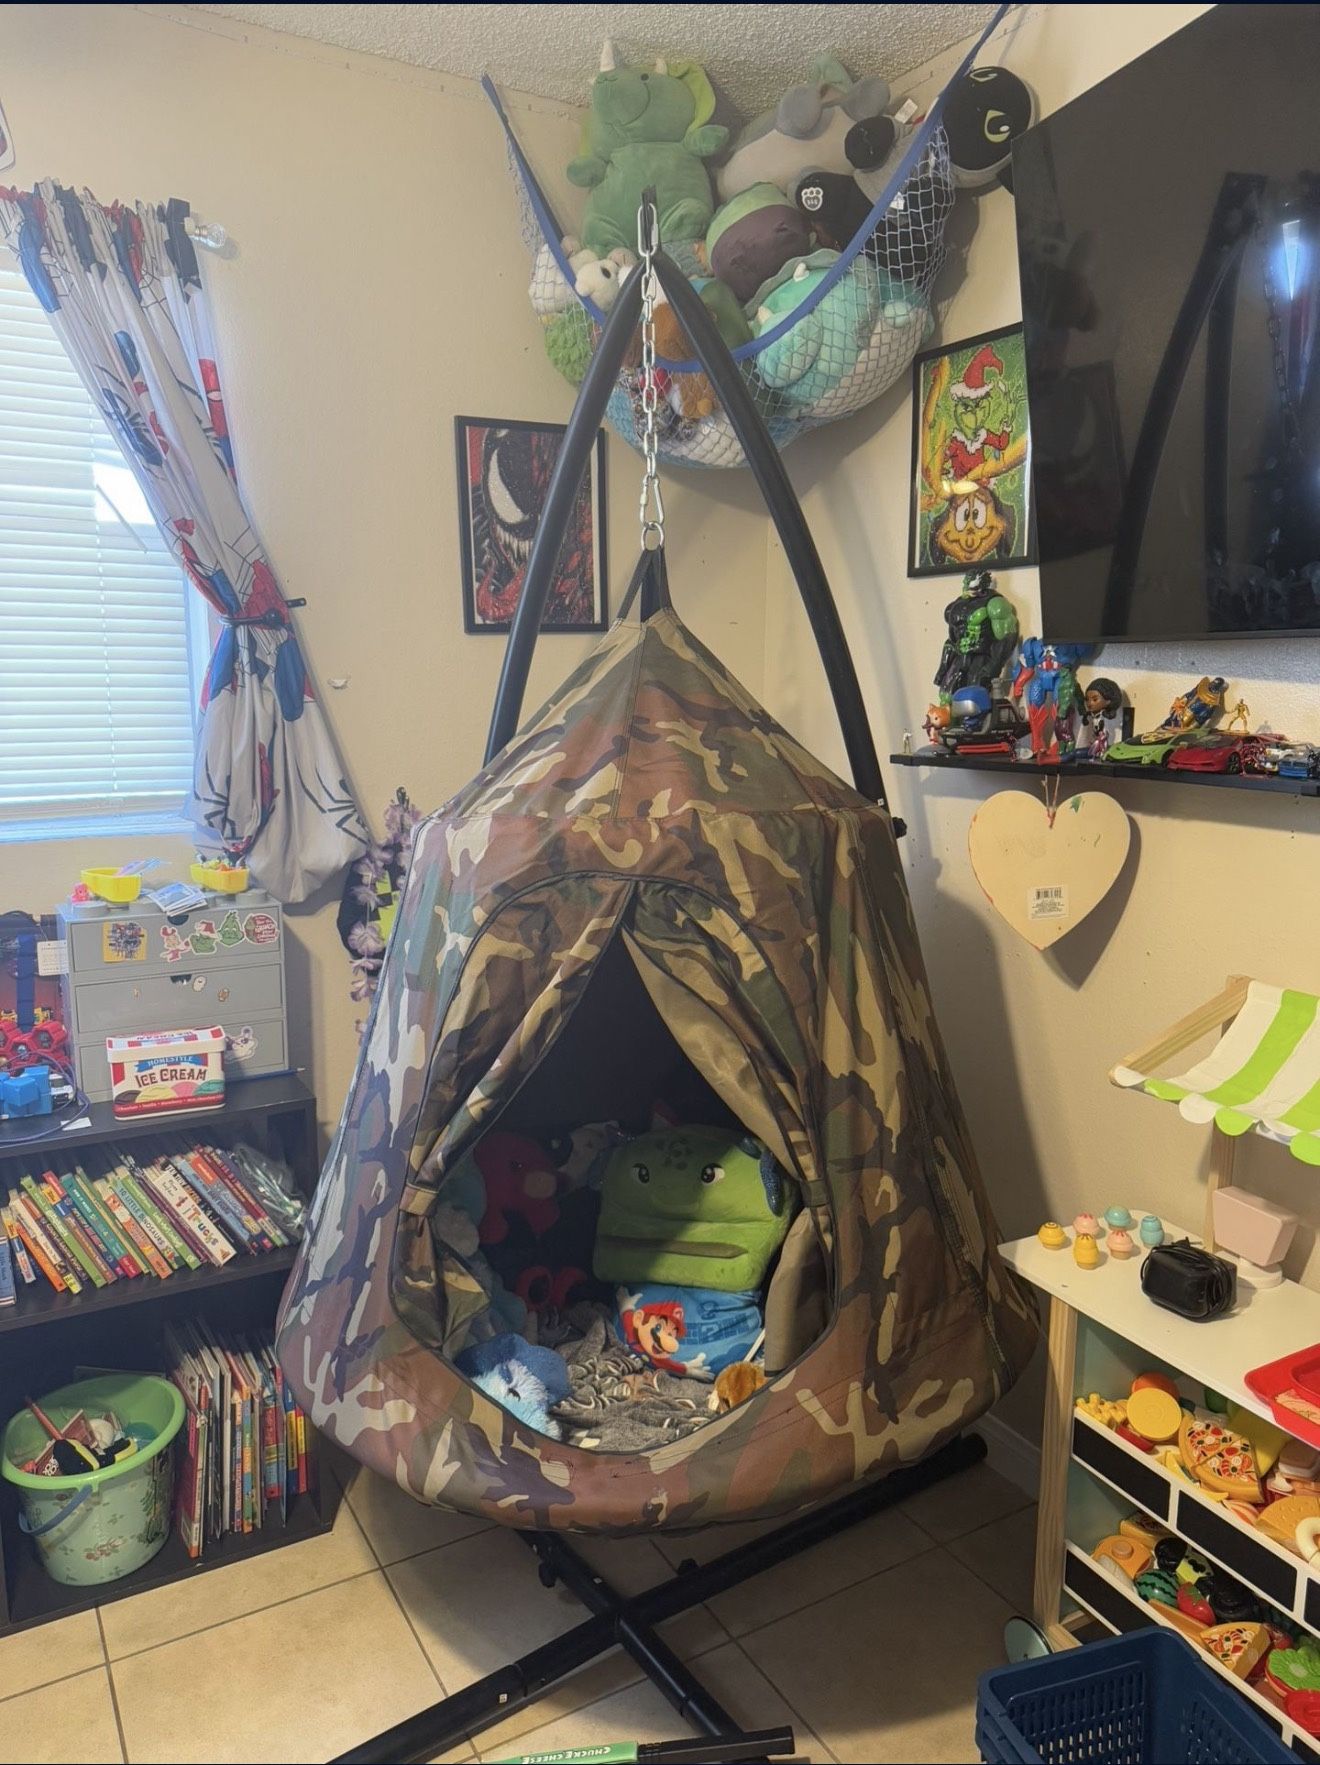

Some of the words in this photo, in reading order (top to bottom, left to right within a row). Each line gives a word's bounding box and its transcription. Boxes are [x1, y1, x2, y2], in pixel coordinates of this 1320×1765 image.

[147, 1056, 194, 1067] HOMESTYLE
[134, 1072, 159, 1088] ICE
[160, 1068, 208, 1082] CREAM
[123, 1194, 141, 1214] LITTLE
[137, 1212, 165, 1246] DINOSAURS
